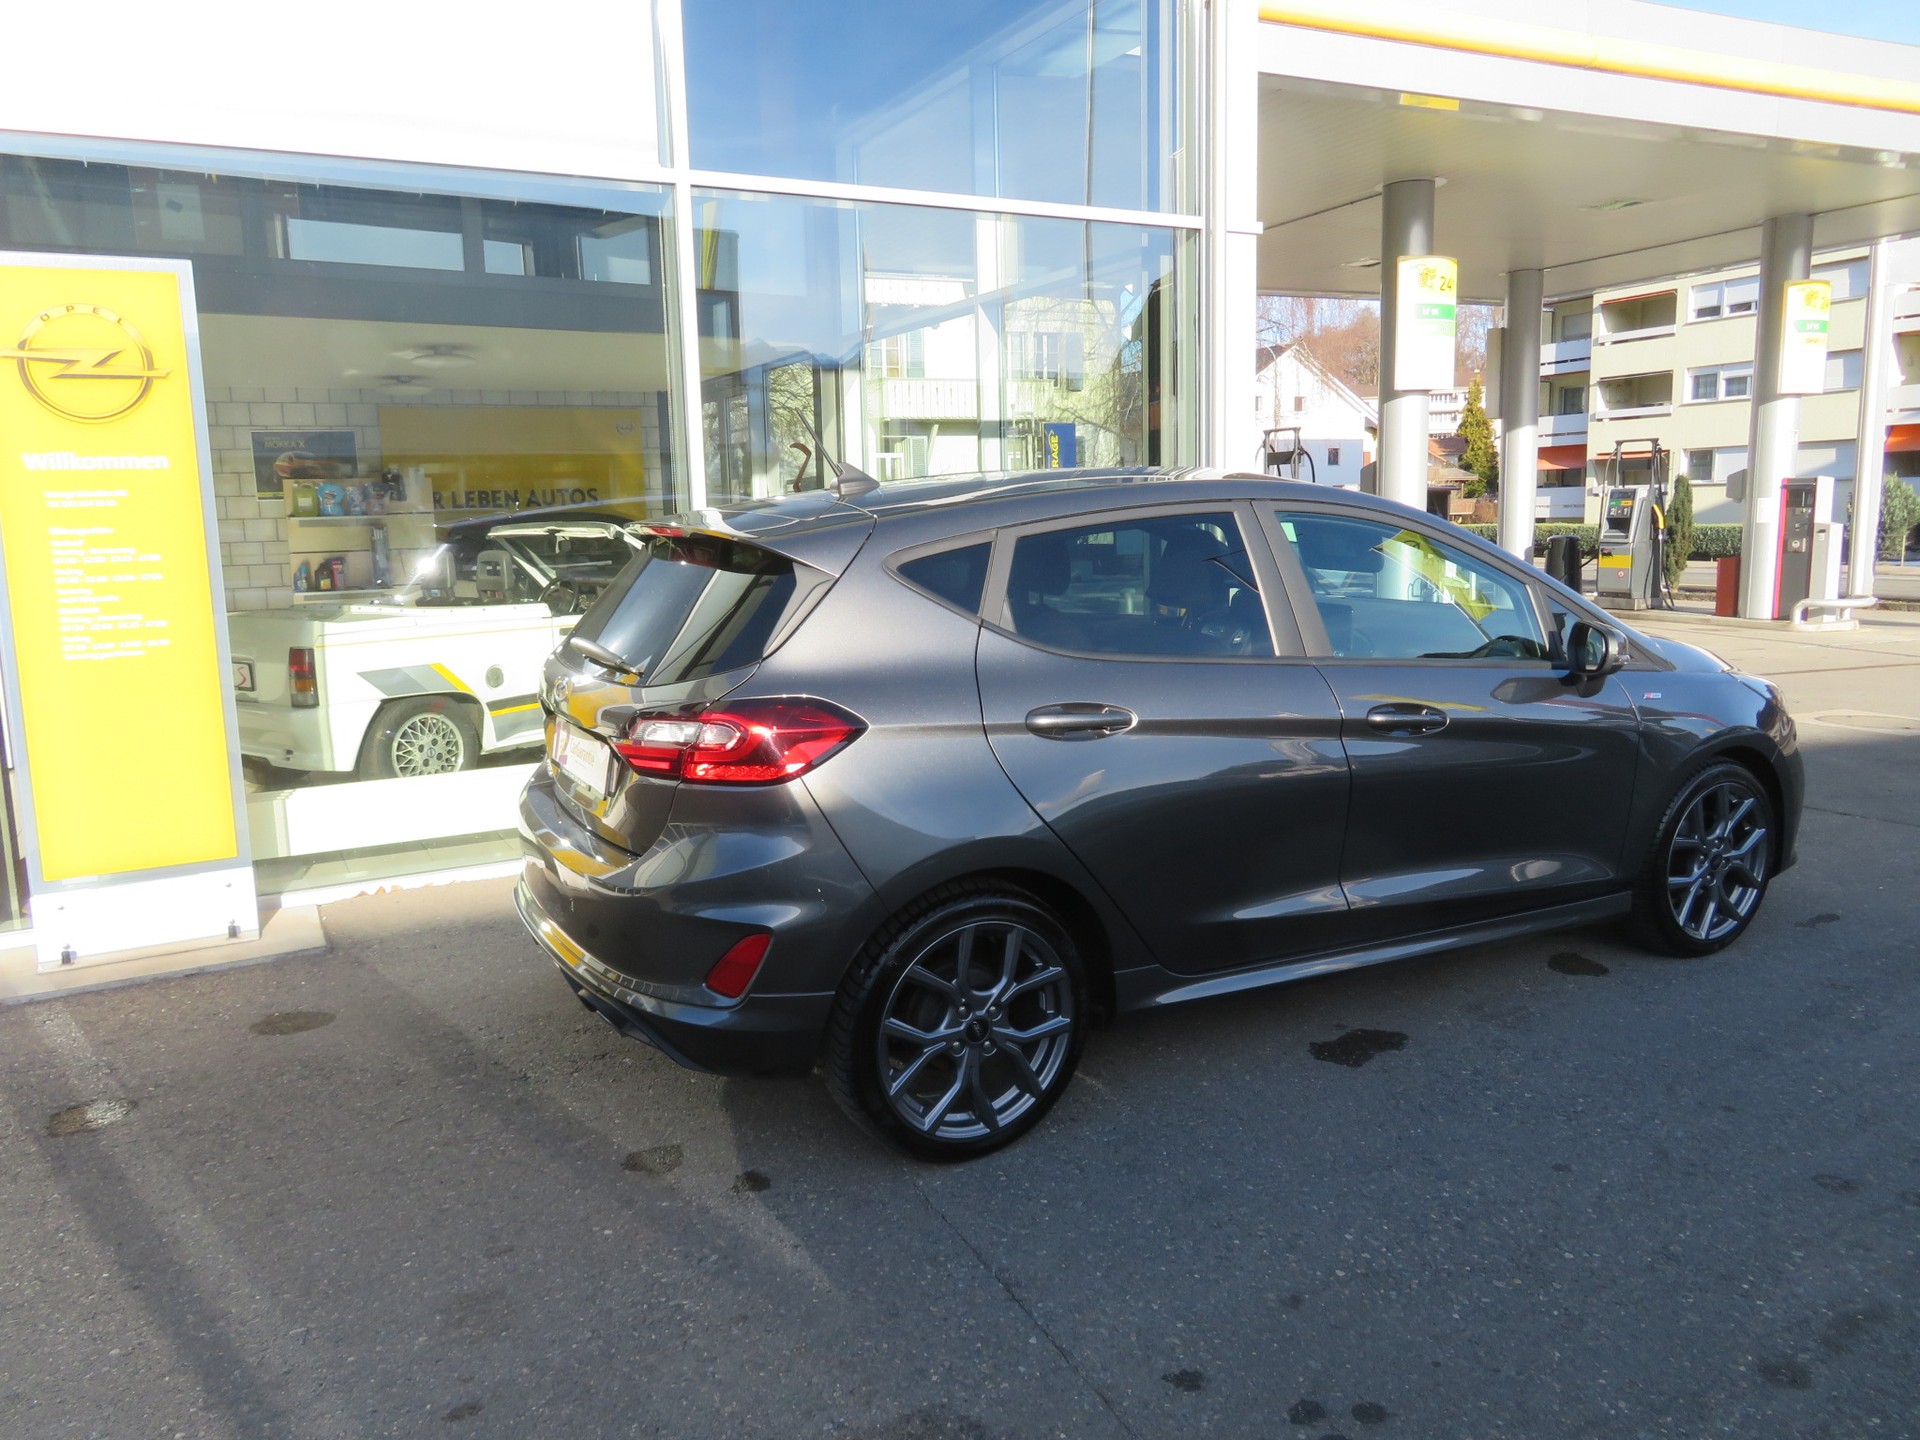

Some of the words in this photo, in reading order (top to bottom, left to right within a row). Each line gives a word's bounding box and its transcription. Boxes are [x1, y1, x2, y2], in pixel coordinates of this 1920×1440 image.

[40, 304, 123, 326] OPEL
[21, 451, 170, 470] Willkommen
[451, 489, 520, 509] LEBEN
[526, 488, 598, 508] AUTOS
